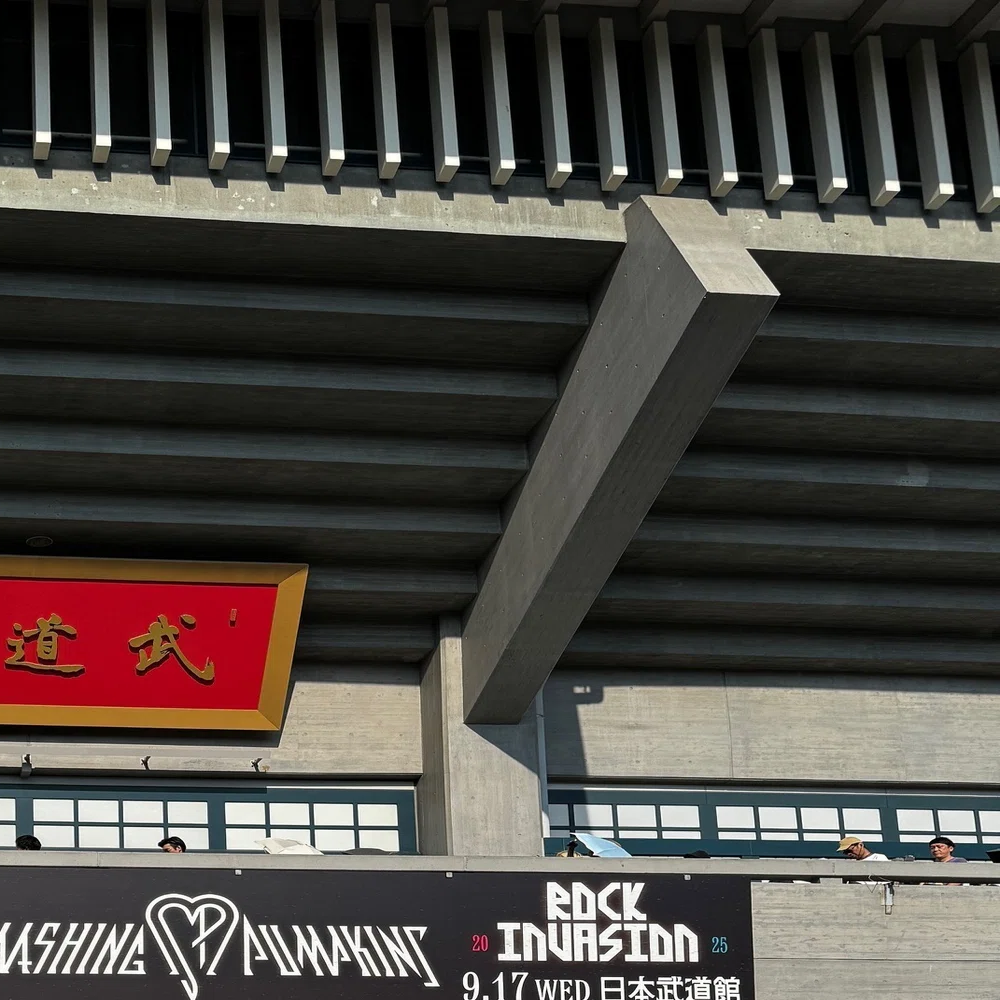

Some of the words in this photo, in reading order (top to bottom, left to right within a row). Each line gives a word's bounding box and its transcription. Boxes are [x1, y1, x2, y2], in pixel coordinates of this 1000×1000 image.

[546, 881, 647, 921] ROCK
[243, 913, 441, 988] PUMPKINS
[471, 934, 489, 952] 20
[496, 922, 700, 963] INVASION
[711, 935, 729, 954] 25
